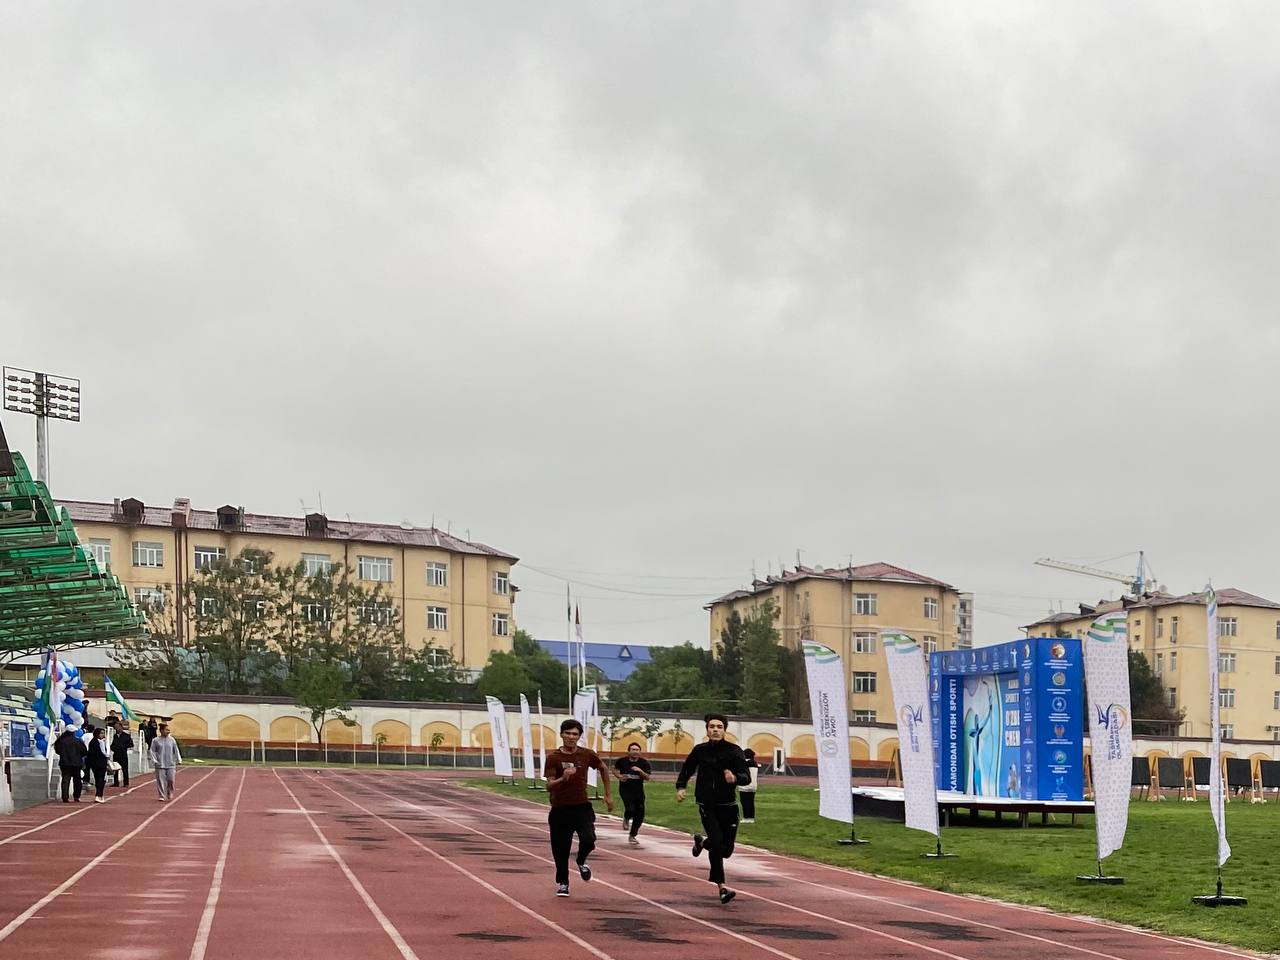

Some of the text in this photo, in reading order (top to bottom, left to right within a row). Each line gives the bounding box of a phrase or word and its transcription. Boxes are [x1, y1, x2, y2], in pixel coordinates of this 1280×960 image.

[949, 679, 957, 793] KAMONDAN OTISH SPORTI
